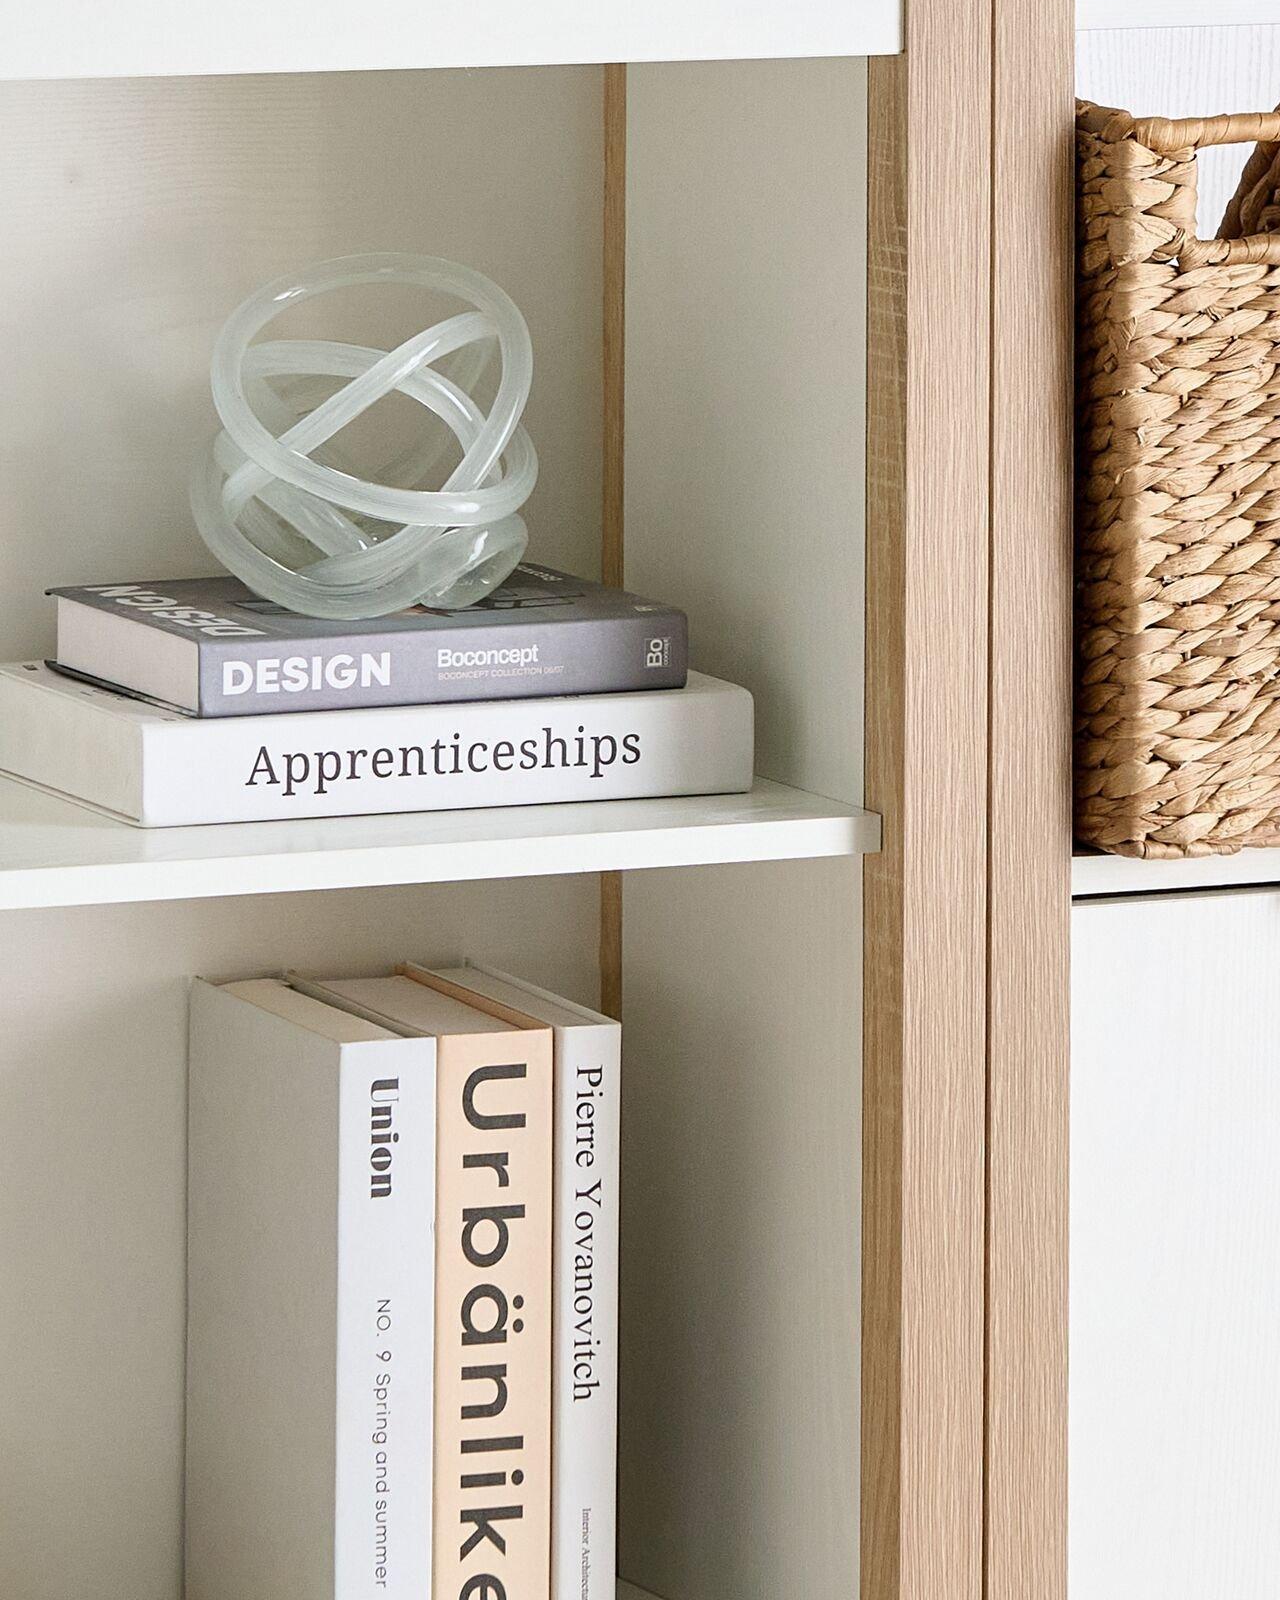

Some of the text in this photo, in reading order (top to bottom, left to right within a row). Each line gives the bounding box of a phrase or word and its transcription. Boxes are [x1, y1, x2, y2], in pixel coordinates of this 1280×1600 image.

[84, 585, 267, 636] DESIGN
[222, 651, 391, 695] DESIGN
[437, 644, 539, 668] Boconcept
[438, 669, 490, 680] BOCONCEPT
[490, 666, 542, 678] COLLECTION
[646, 639, 663, 668] Bo
[245, 725, 643, 796] Apprenticeships
[370, 1077, 400, 1200] Union
[572, 1064, 604, 1403] Pierre Yovanovitch
[371, 1299, 392, 1589] NO. 9 Spring and summer
[581, 1507, 592, 1545] Interior
